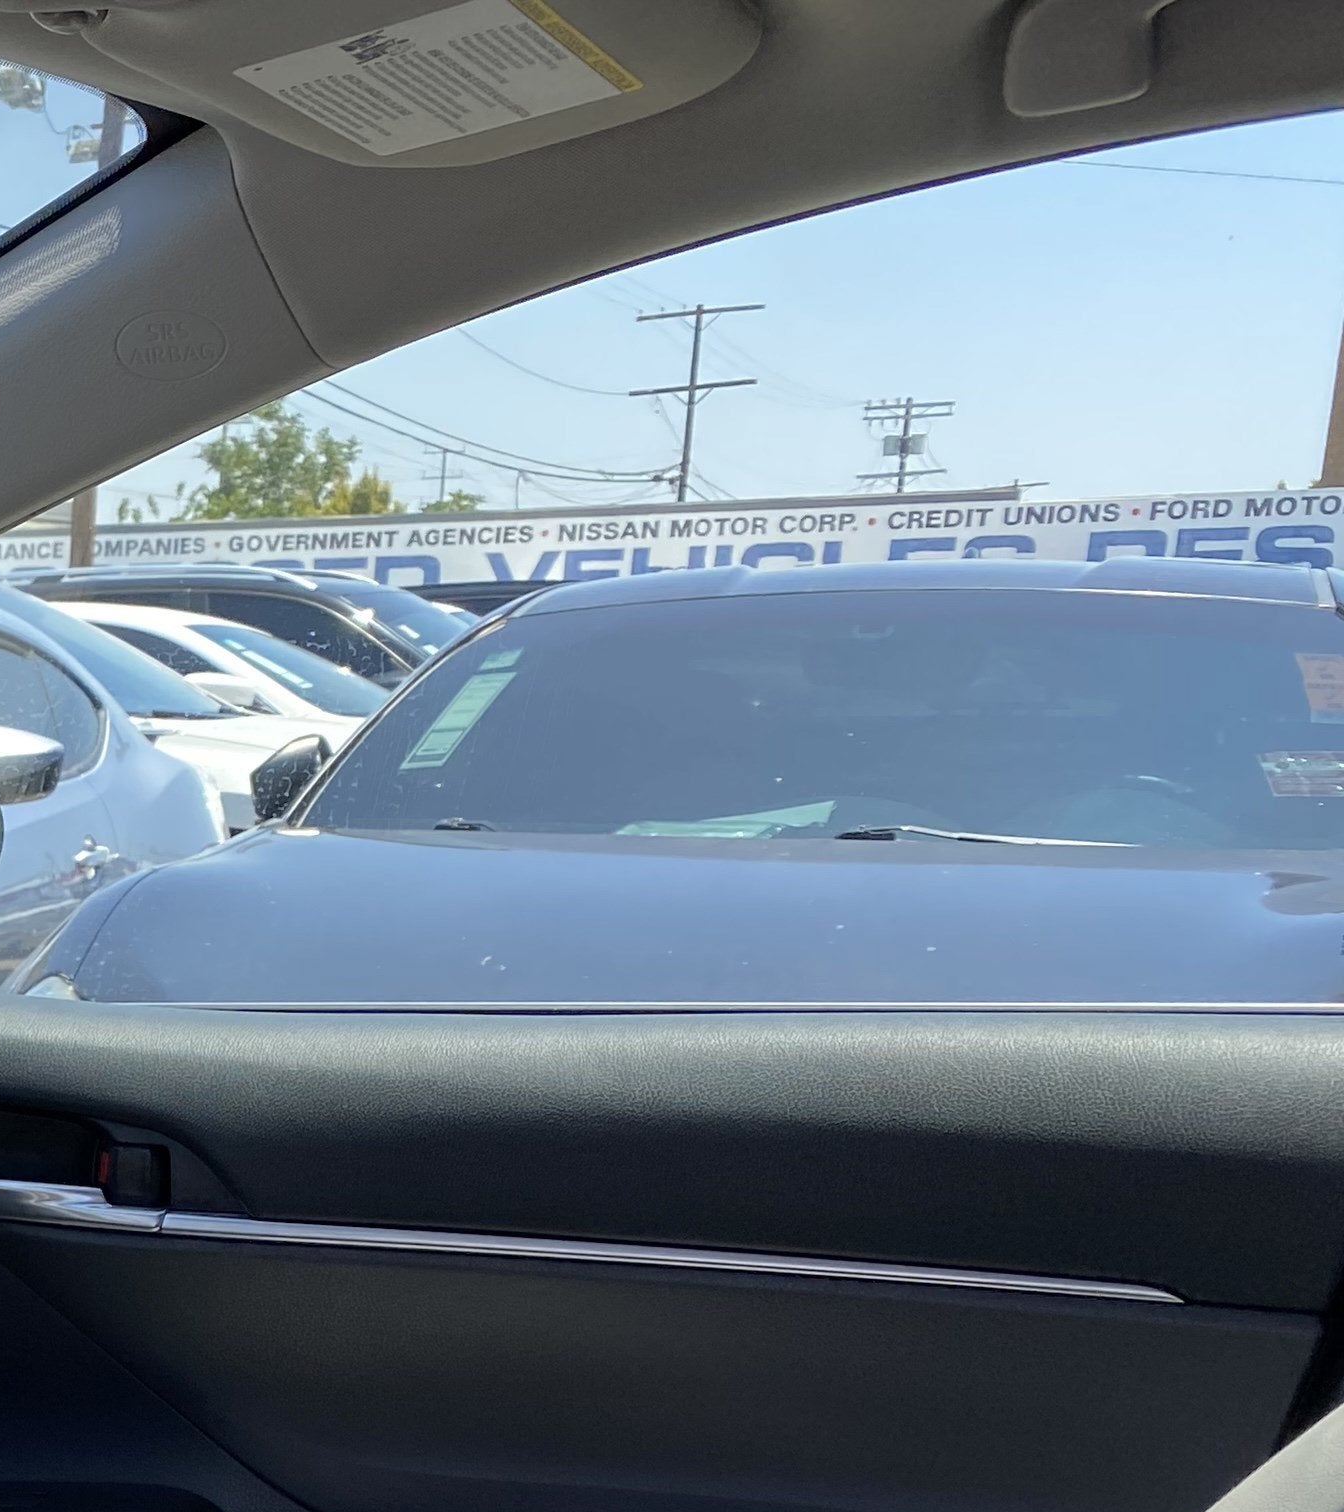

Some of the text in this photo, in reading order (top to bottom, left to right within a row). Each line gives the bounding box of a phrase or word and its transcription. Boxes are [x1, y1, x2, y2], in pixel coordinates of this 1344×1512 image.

[91, 537, 207, 558] OMPANIES
[228, 530, 400, 553] GOVERNMENT
[406, 524, 534, 548] AGENCIES
[556, 519, 660, 543] NISSAN
[669, 515, 768, 539] MOTOR
[779, 512, 859, 535] CORP.
[886, 507, 994, 530] CREDIT
[1002, 502, 1121, 526] UNIONS
[1148, 498, 1233, 521] FORD
[1244, 494, 1344, 518] MOTO
